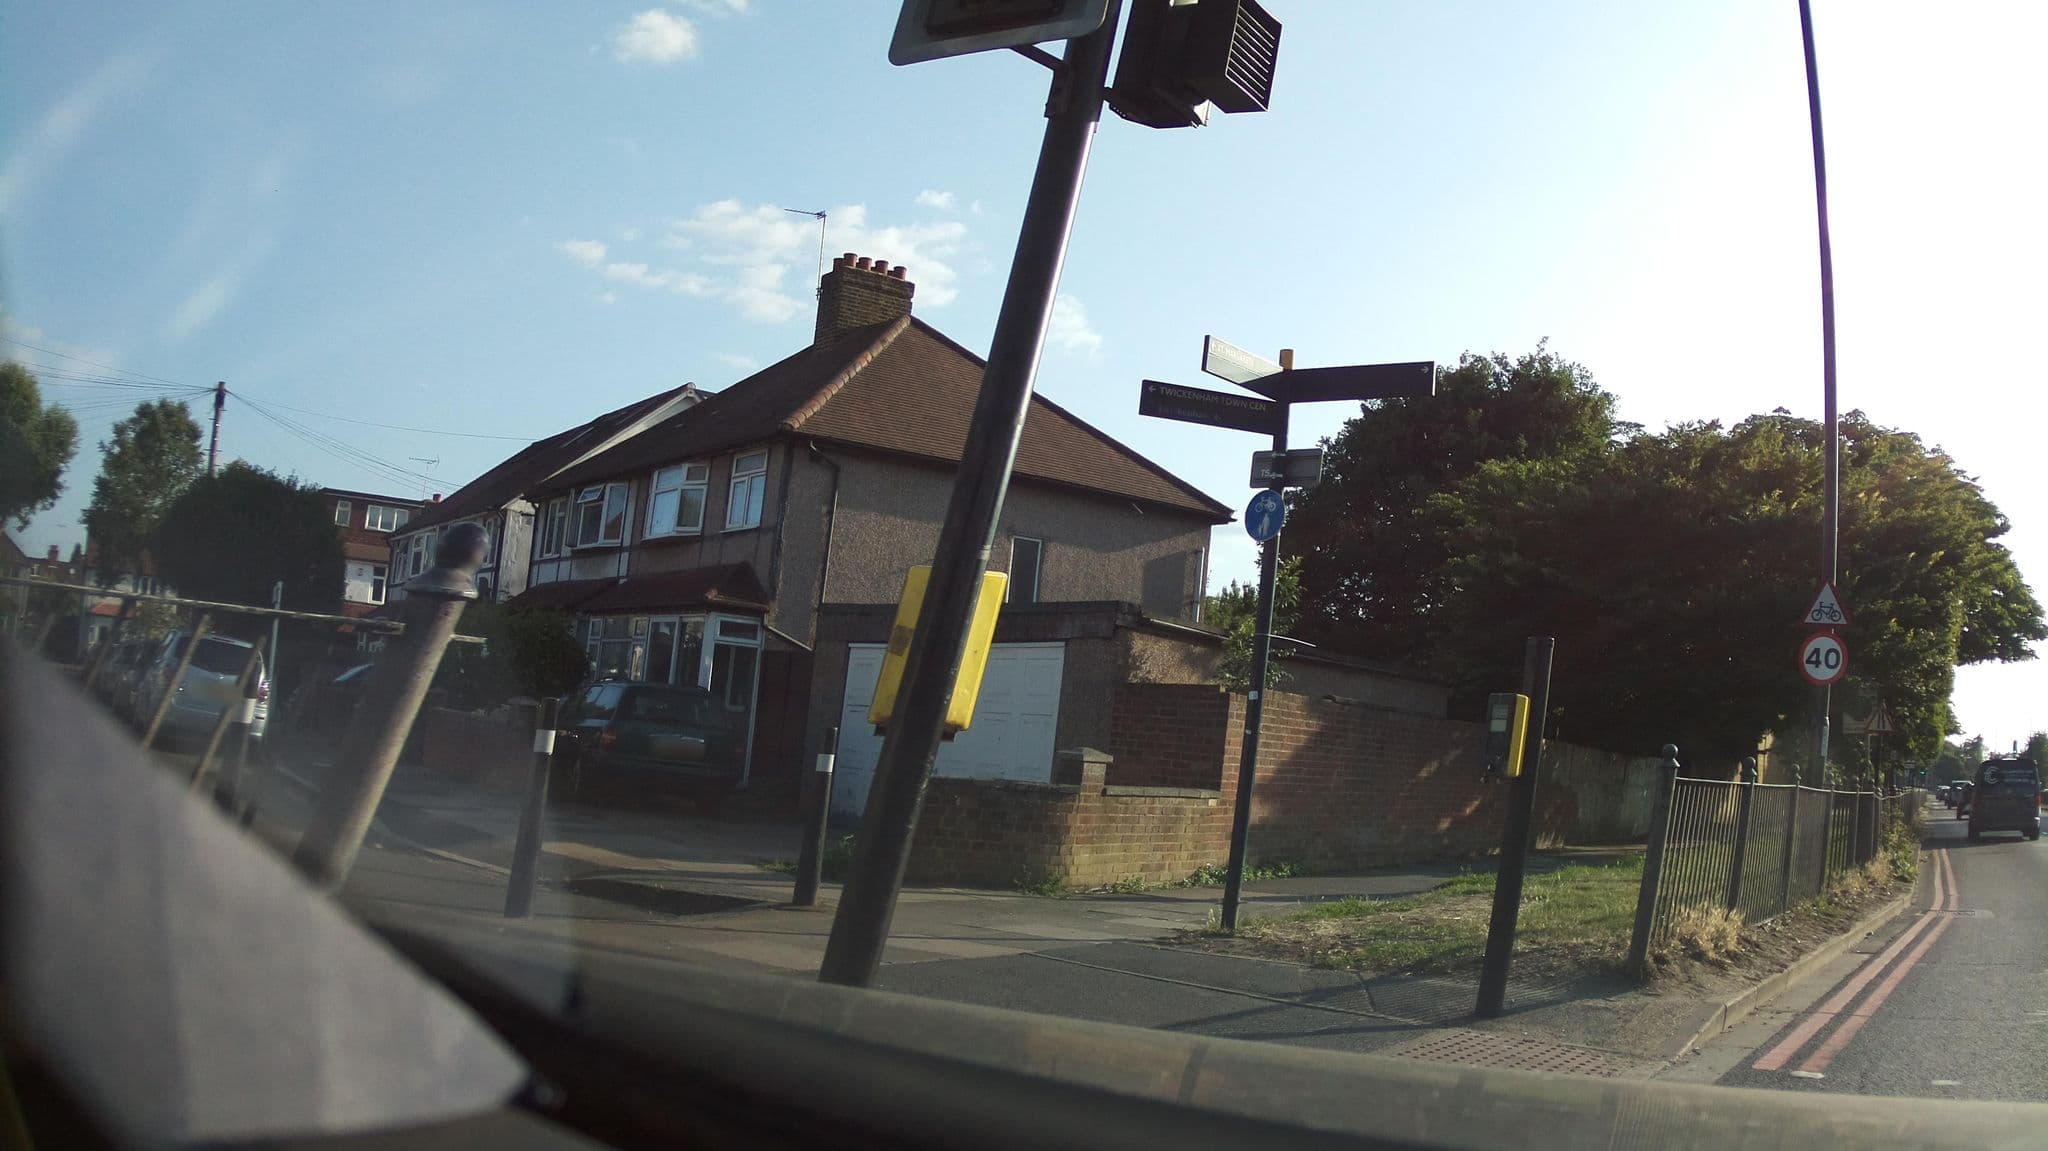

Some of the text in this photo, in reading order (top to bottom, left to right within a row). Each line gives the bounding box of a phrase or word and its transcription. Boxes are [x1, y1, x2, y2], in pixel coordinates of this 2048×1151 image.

[1160, 386, 1219, 402] TWICKENHAM
[1221, 396, 1248, 409] TOWN
[1806, 647, 1841, 670] 40
